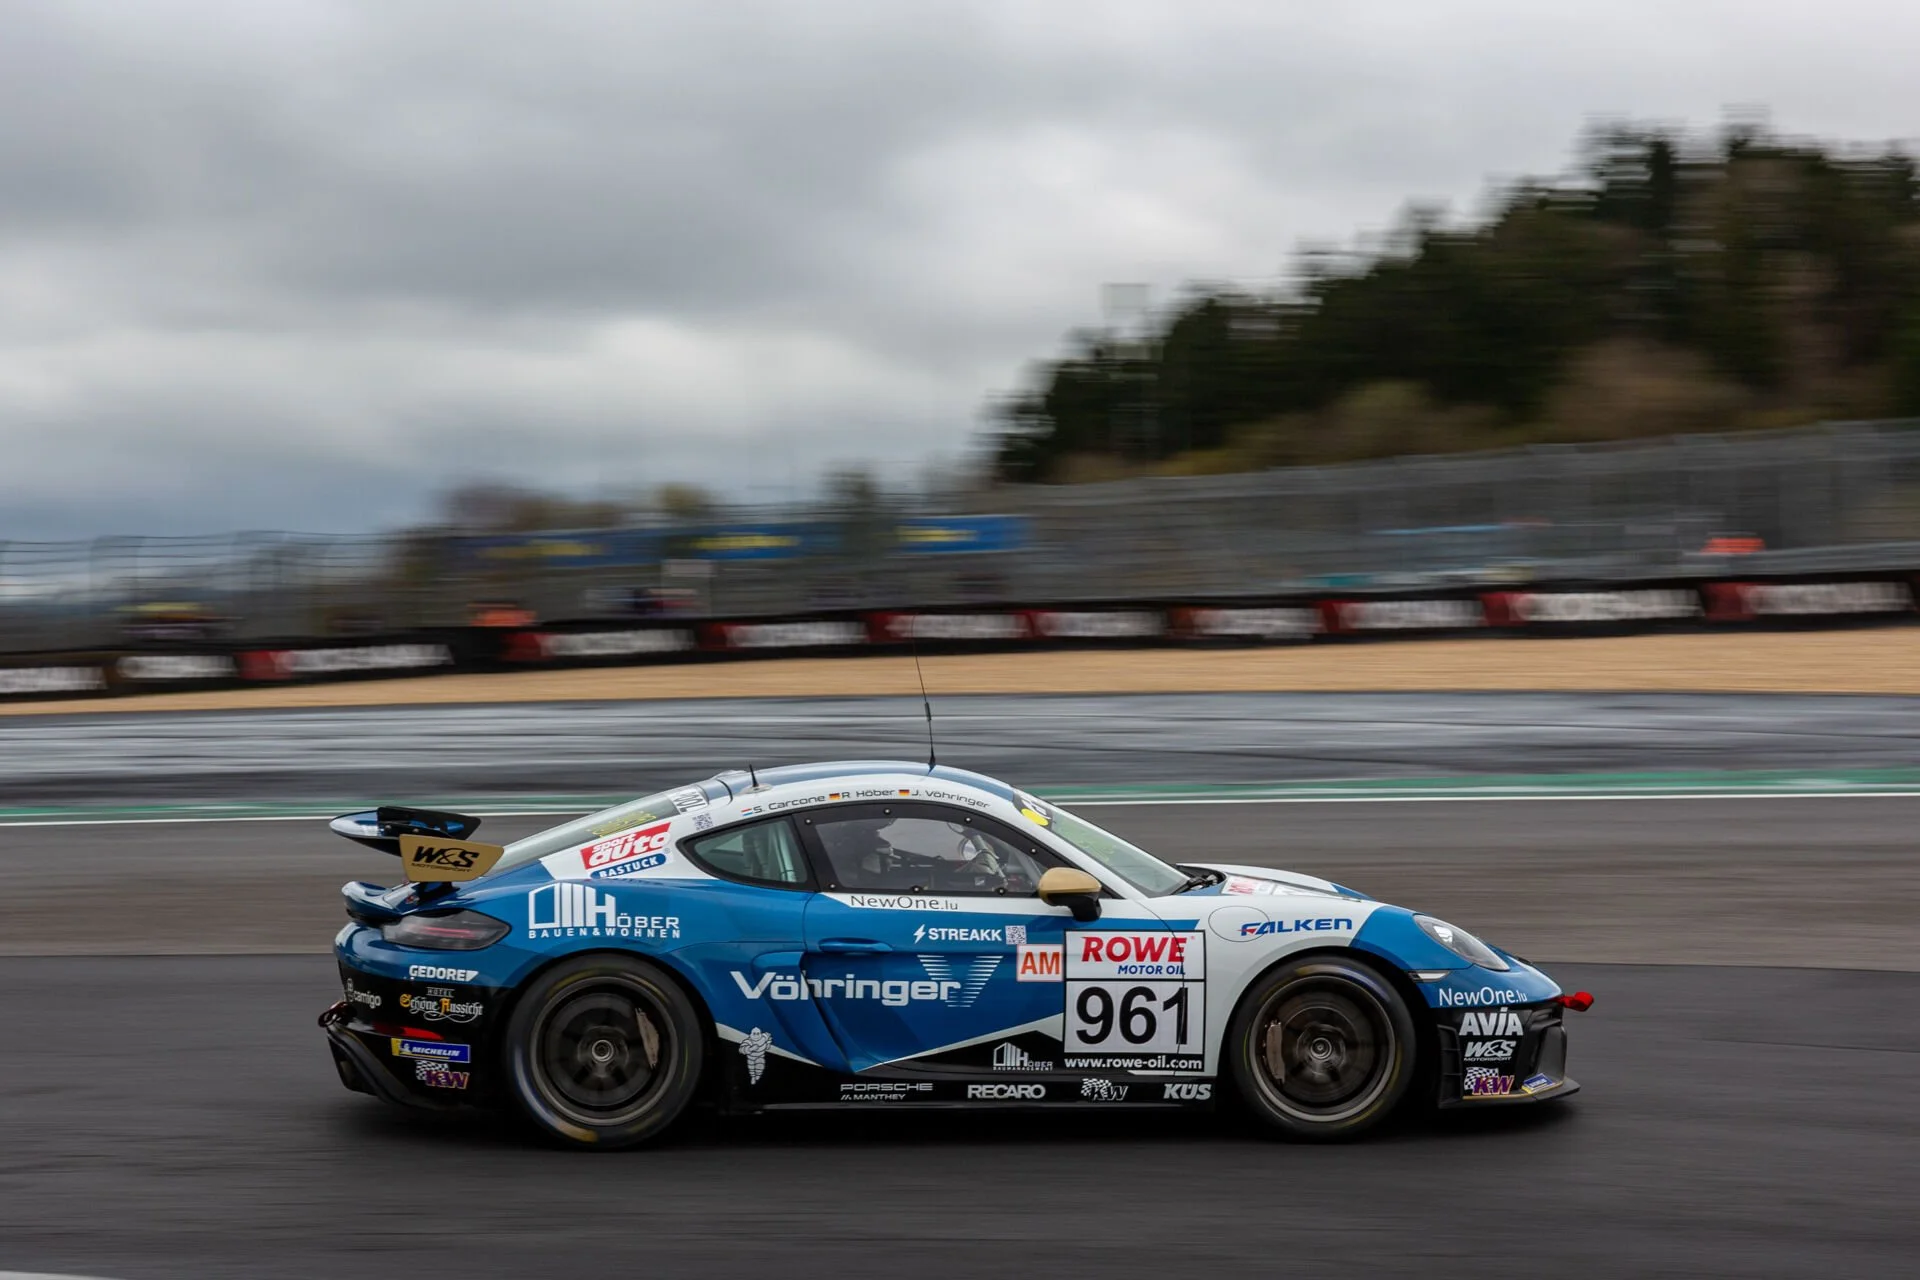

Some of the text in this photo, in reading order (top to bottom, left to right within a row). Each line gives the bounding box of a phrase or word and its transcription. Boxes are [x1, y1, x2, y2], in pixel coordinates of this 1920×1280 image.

[856, 789, 895, 797] Höber
[925, 790, 990, 809] Vöhringer
[769, 795, 825, 810] Carcone
[589, 831, 671, 866] auto
[592, 833, 637, 853] sport
[412, 846, 480, 867] W&S
[411, 863, 472, 872] MOTORSPORT
[599, 856, 659, 878] BASTUCK
[851, 895, 958, 910] NewOne.lu
[928, 928, 1002, 942] STREAKK
[1240, 918, 1352, 936] FALKEN
[1081, 936, 1187, 962] ROWE
[1021, 951, 1060, 975] AM
[1118, 965, 1186, 974] MOTOR OIL
[409, 965, 466, 981] GEDORE
[730, 971, 961, 1006] Vöhringer
[1439, 986, 1527, 1006] NewOne.lu
[400, 993, 484, 1016] Schöne Aussicht
[1076, 986, 1188, 1045] 961
[412, 1047, 460, 1057] MICHELIN
[1464, 1040, 1516, 1057] W&S
[1064, 1056, 1203, 1069] www.rowe-oil.com
[424, 1069, 471, 1090] KW
[841, 1083, 934, 1091] PORSCHE
[1471, 1075, 1514, 1095] KW
[967, 1084, 1046, 1099] RECARO
[1163, 1084, 1212, 1100] KÜS
